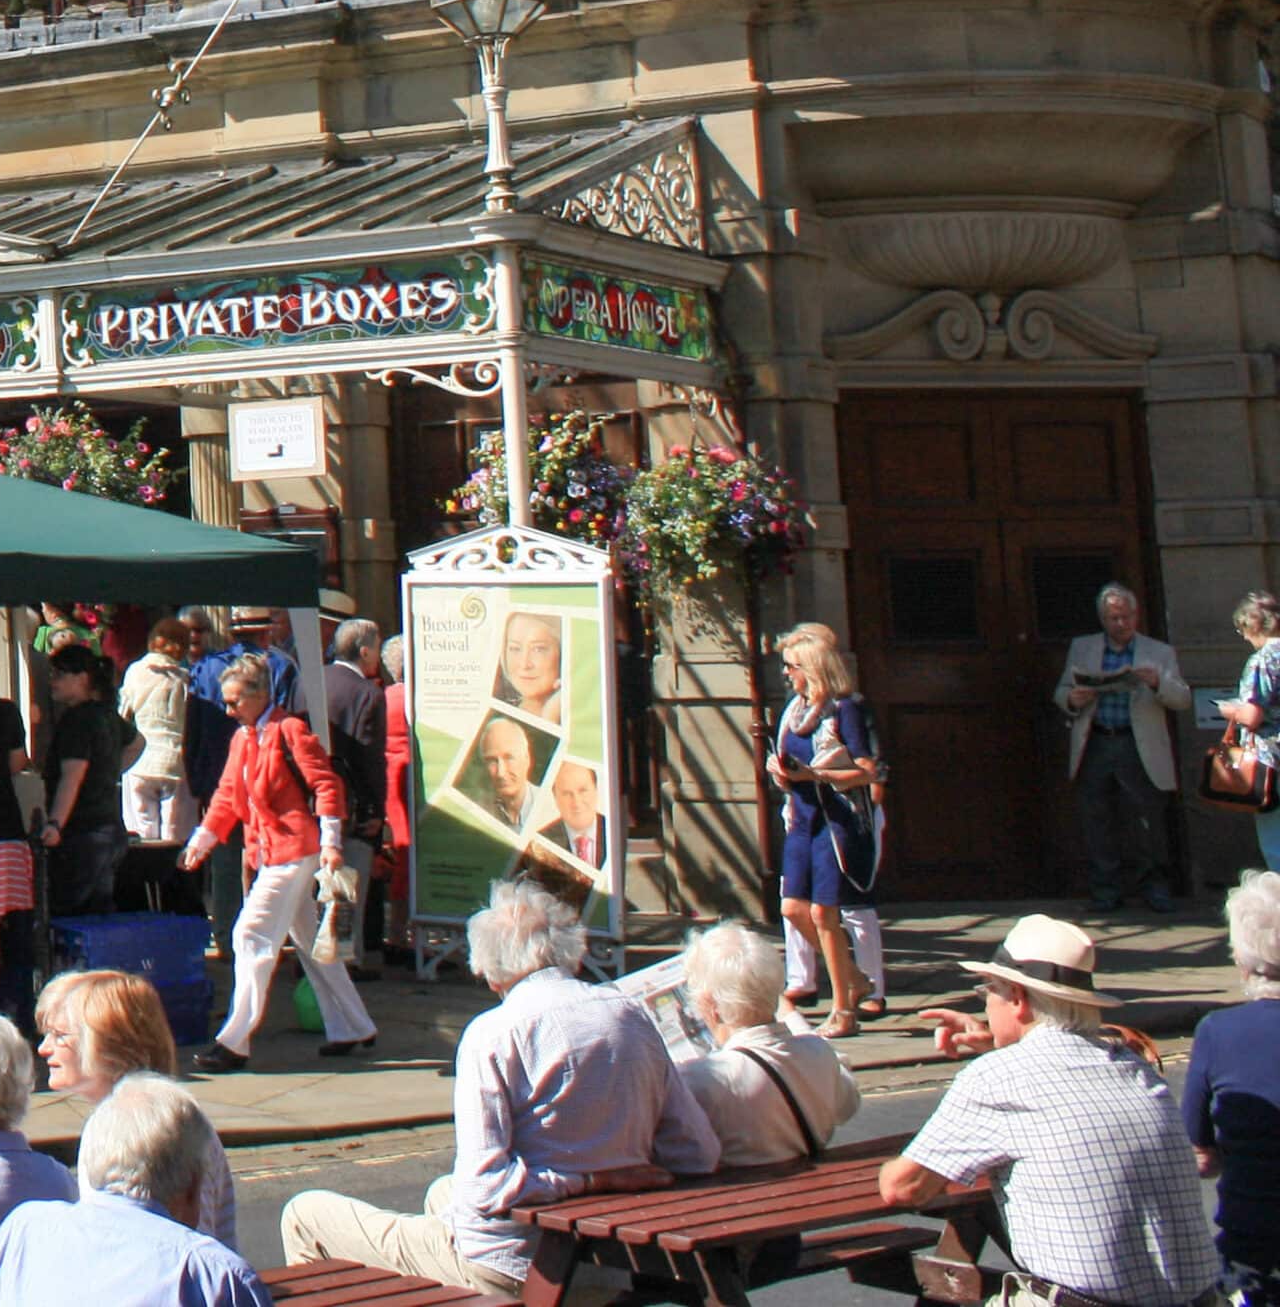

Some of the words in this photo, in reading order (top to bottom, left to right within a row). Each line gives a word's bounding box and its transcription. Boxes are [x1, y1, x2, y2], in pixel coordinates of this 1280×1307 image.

[97, 298, 281, 345] PRIVATE
[301, 278, 458, 327] BOXES
[542, 278, 612, 328] OPERA
[617, 292, 679, 338] HOUSE
[422, 614, 469, 632] Buxton
[423, 634, 469, 652] Festival
